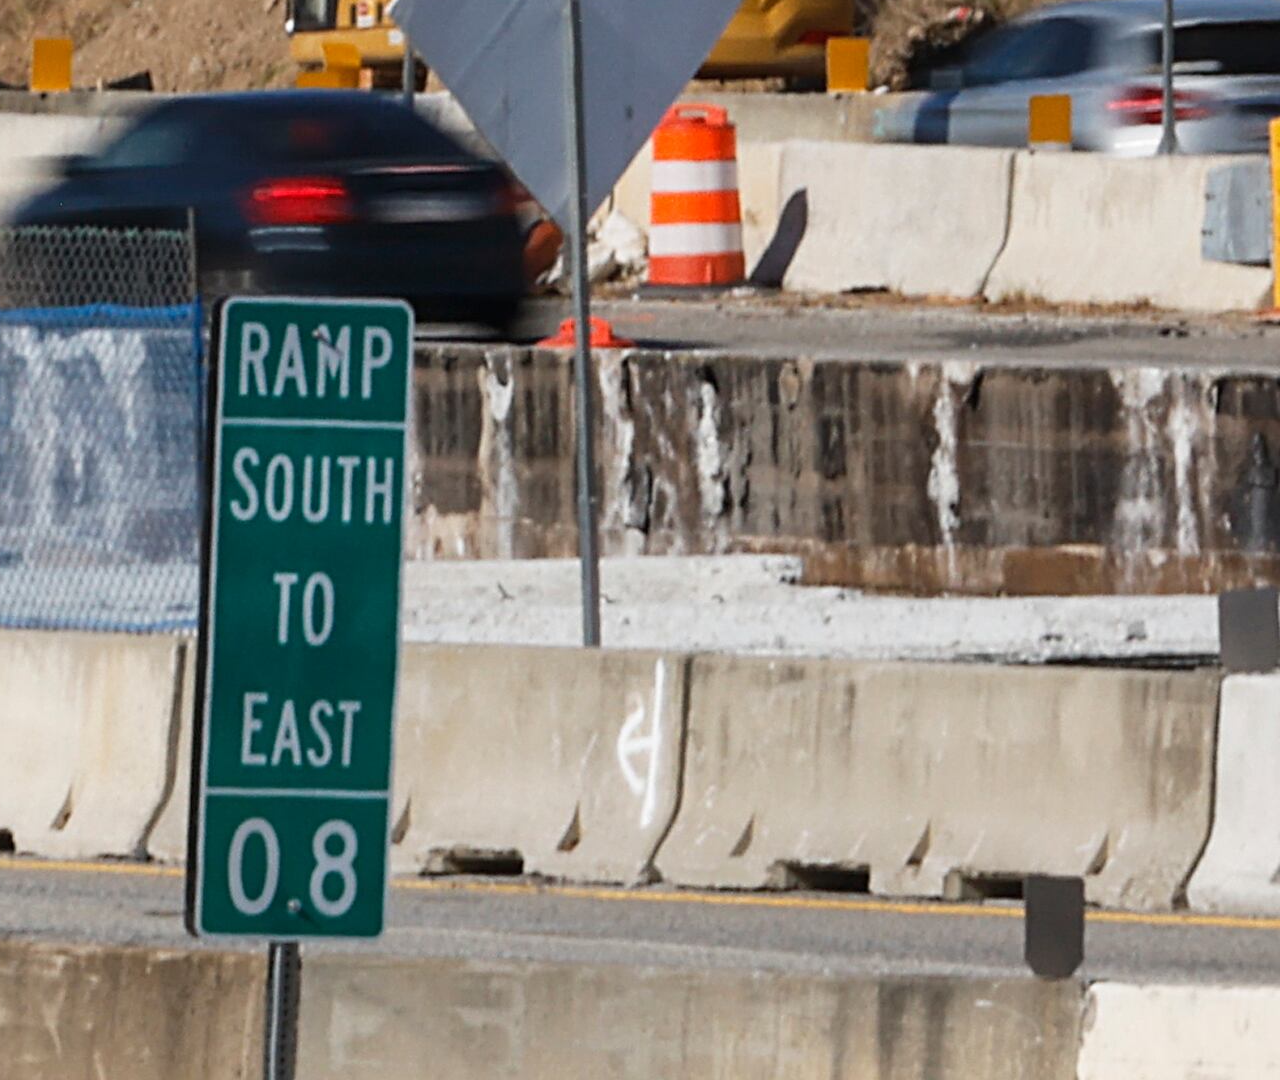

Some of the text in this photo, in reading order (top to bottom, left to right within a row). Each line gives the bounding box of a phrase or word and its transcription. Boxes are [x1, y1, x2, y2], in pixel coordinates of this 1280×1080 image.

[238, 320, 394, 400] RAMP
[229, 446, 395, 524] SOUTH
[273, 572, 336, 647] TO
[240, 691, 363, 769] EAST
